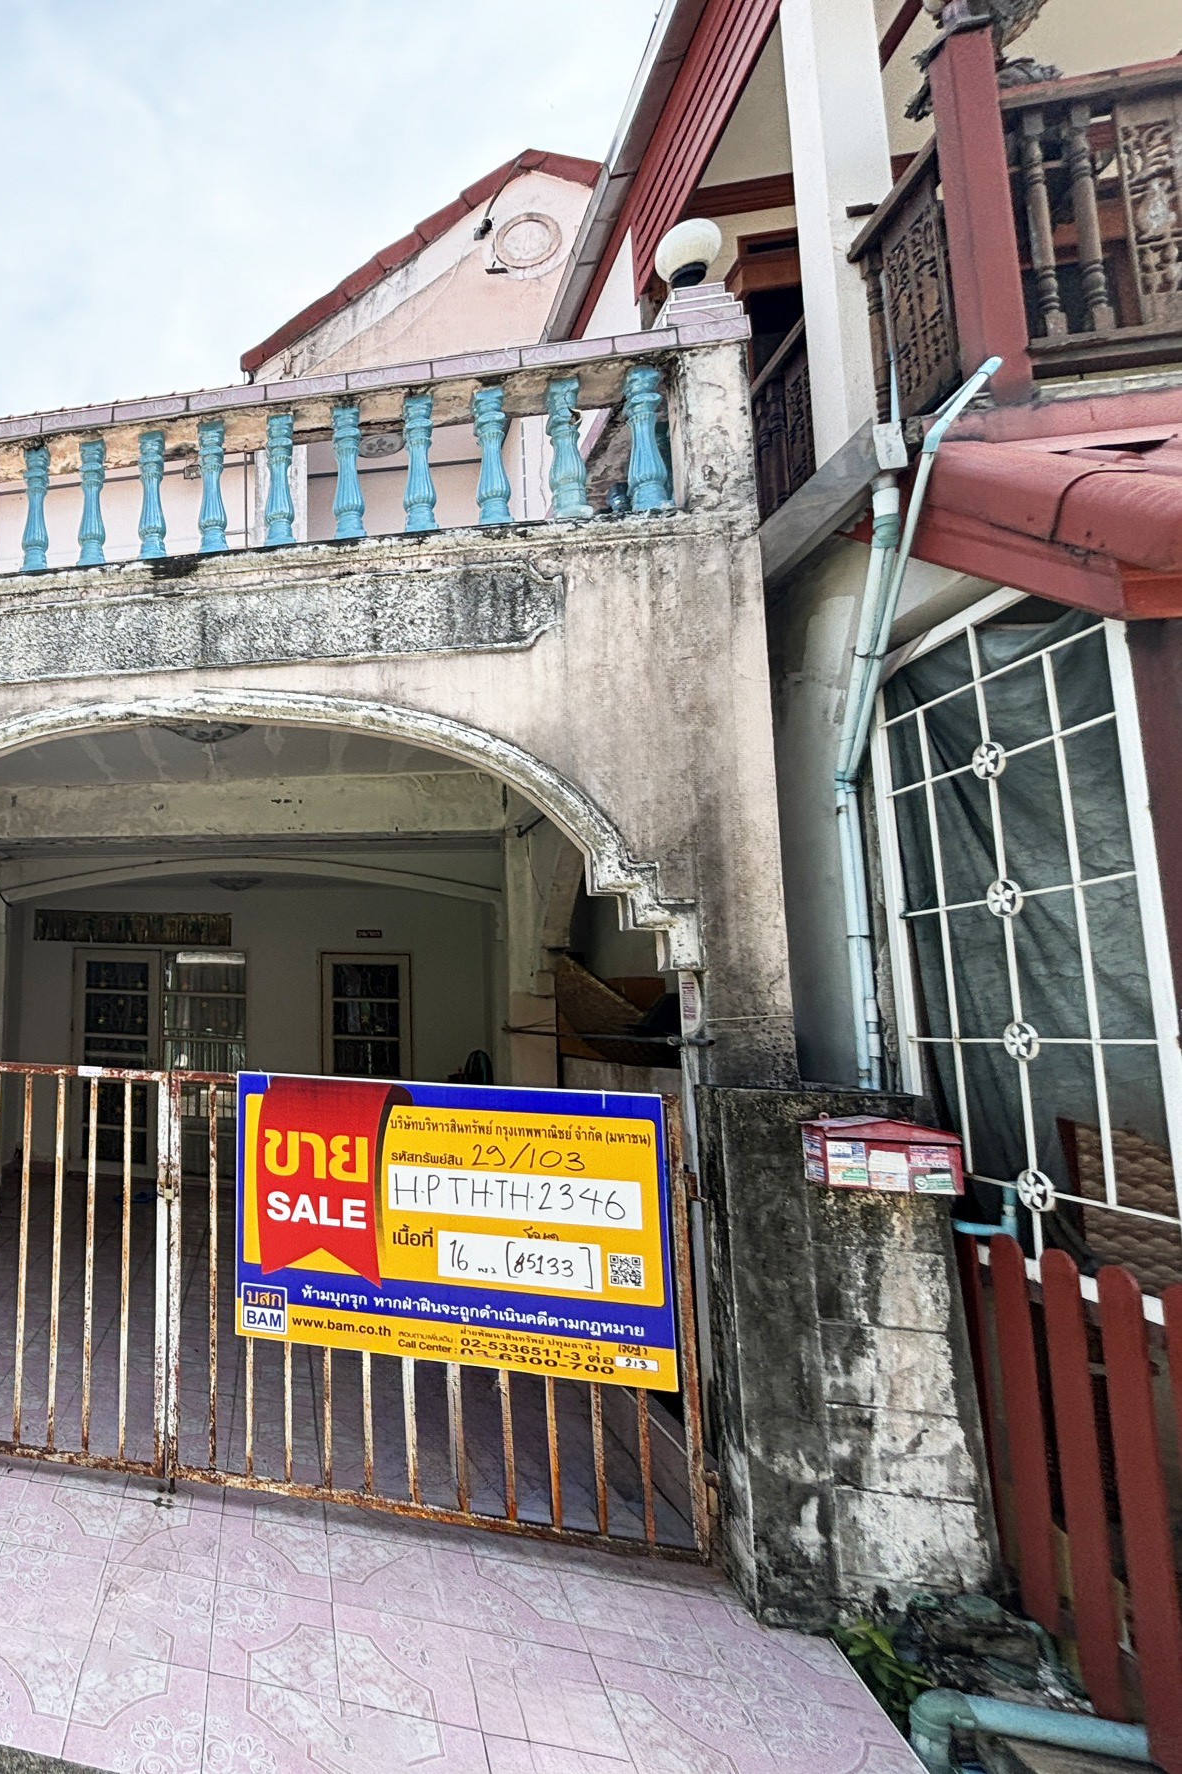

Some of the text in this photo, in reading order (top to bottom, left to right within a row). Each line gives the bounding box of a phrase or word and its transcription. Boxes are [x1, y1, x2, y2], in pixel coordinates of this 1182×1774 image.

[390, 1116, 652, 1148] บริษัทบริหารสินทรัพย์ กรุงเทพพาณิชย์ จำกัด (มหาชน)
[264, 1129, 369, 1183] ขาย
[391, 1142, 586, 1171] รหัสทรัพย์สิน 29/103
[266, 1191, 367, 1229] SALE
[392, 1224, 434, 1248] เนื้อที่
[449, 1239, 469, 1271] 16
[246, 1290, 282, 1308] บสก
[302, 1285, 644, 1338] ห้ามบุกรุก หากฝ่าฝืนจะถูกดำเนินคดีตามกฎหมาย
[246, 1310, 282, 1328] BAM
[292, 1316, 391, 1337] www.bam.co.th
[398, 1338, 417, 1348] Call
[418, 1341, 452, 1353] Center
[460, 1338, 581, 1361] 02-5336511-3
[588, 1352, 615, 1365] ต่อ
